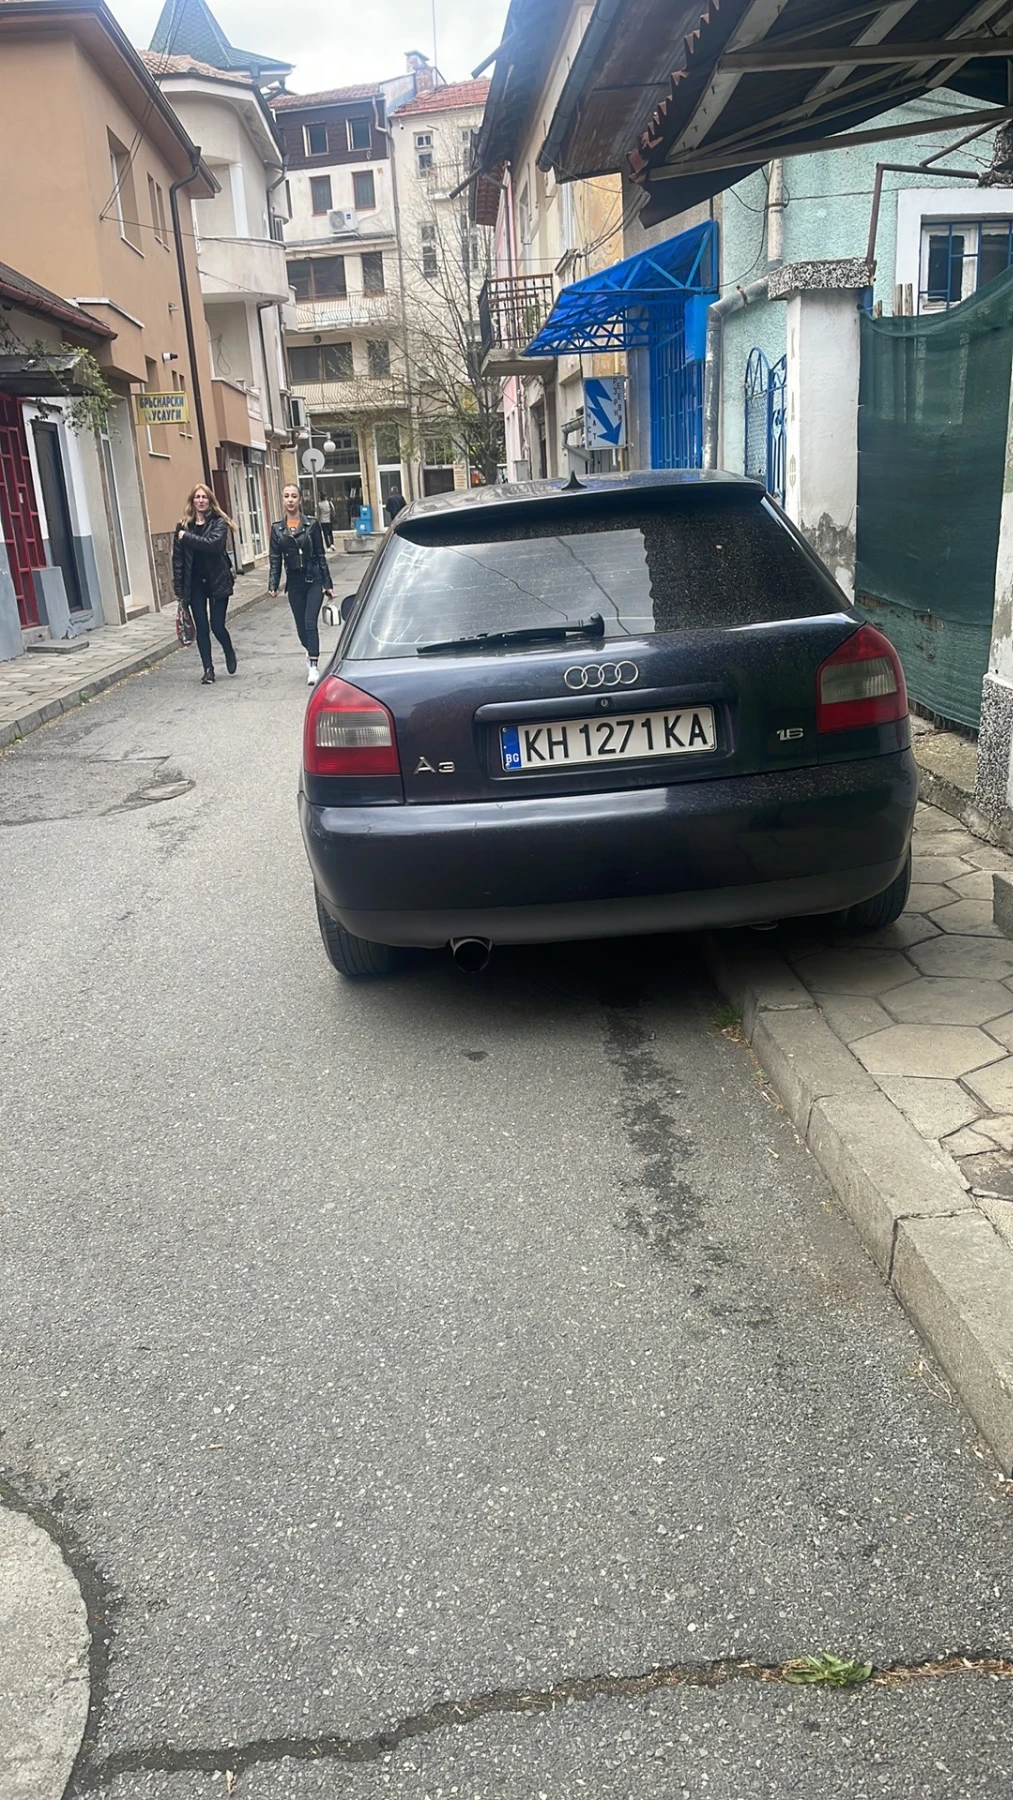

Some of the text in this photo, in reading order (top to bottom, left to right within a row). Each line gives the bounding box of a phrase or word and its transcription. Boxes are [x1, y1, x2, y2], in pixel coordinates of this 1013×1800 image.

[139, 396, 184, 408] БРЪСНАРСКИ
[524, 713, 708, 762] KH 1271 KA
[413, 756, 456, 774] A3
[505, 753, 520, 765] BG
